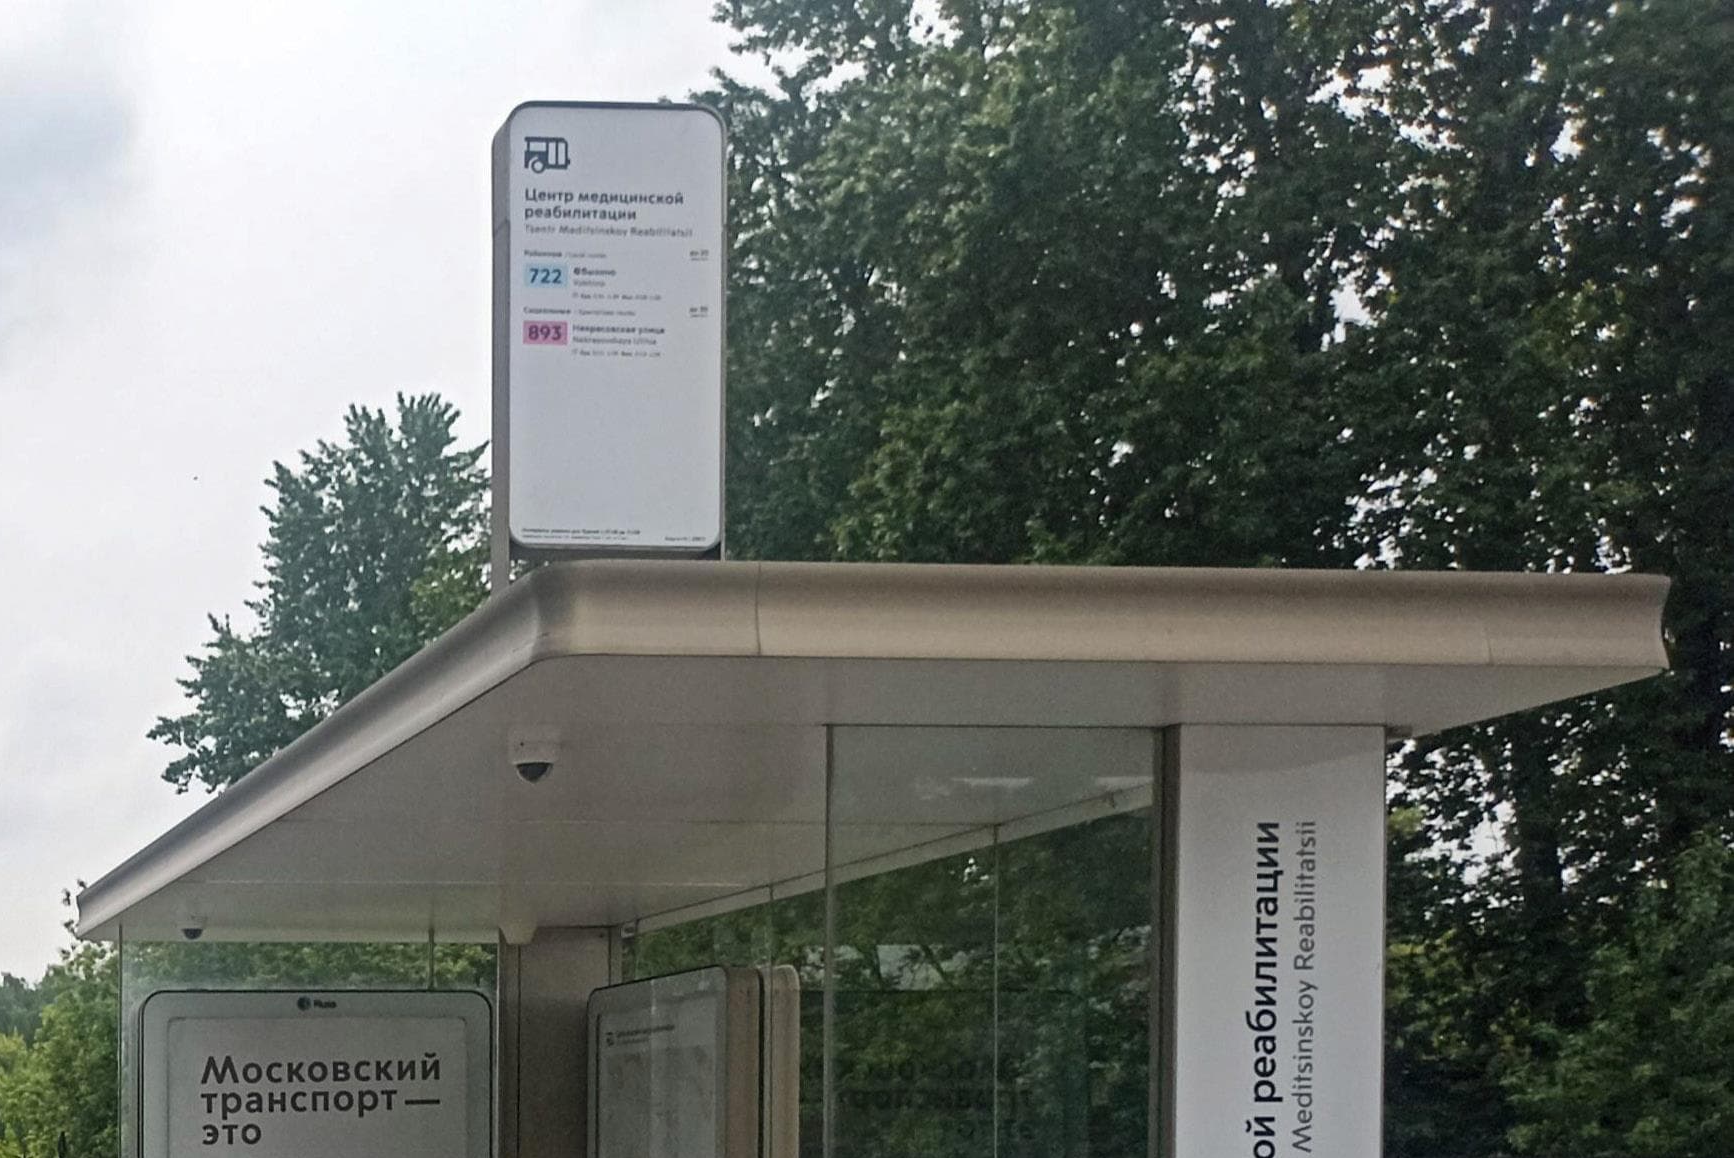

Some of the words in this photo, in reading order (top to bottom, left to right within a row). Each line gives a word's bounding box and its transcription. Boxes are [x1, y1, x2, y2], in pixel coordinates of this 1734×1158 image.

[525, 187, 574, 204] Центр
[578, 191, 684, 205] медицинской
[524, 205, 637, 221] реабилитации
[529, 268, 562, 284] 722
[528, 325, 562, 341] 893
[1293, 820, 1316, 970] Reabilitatsii
[1245, 821, 1284, 1103] реабилитации
[201, 1051, 441, 1085] Московский
[1292, 980, 1318, 1153] Meditsinskoy
[202, 1123, 262, 1146] это
